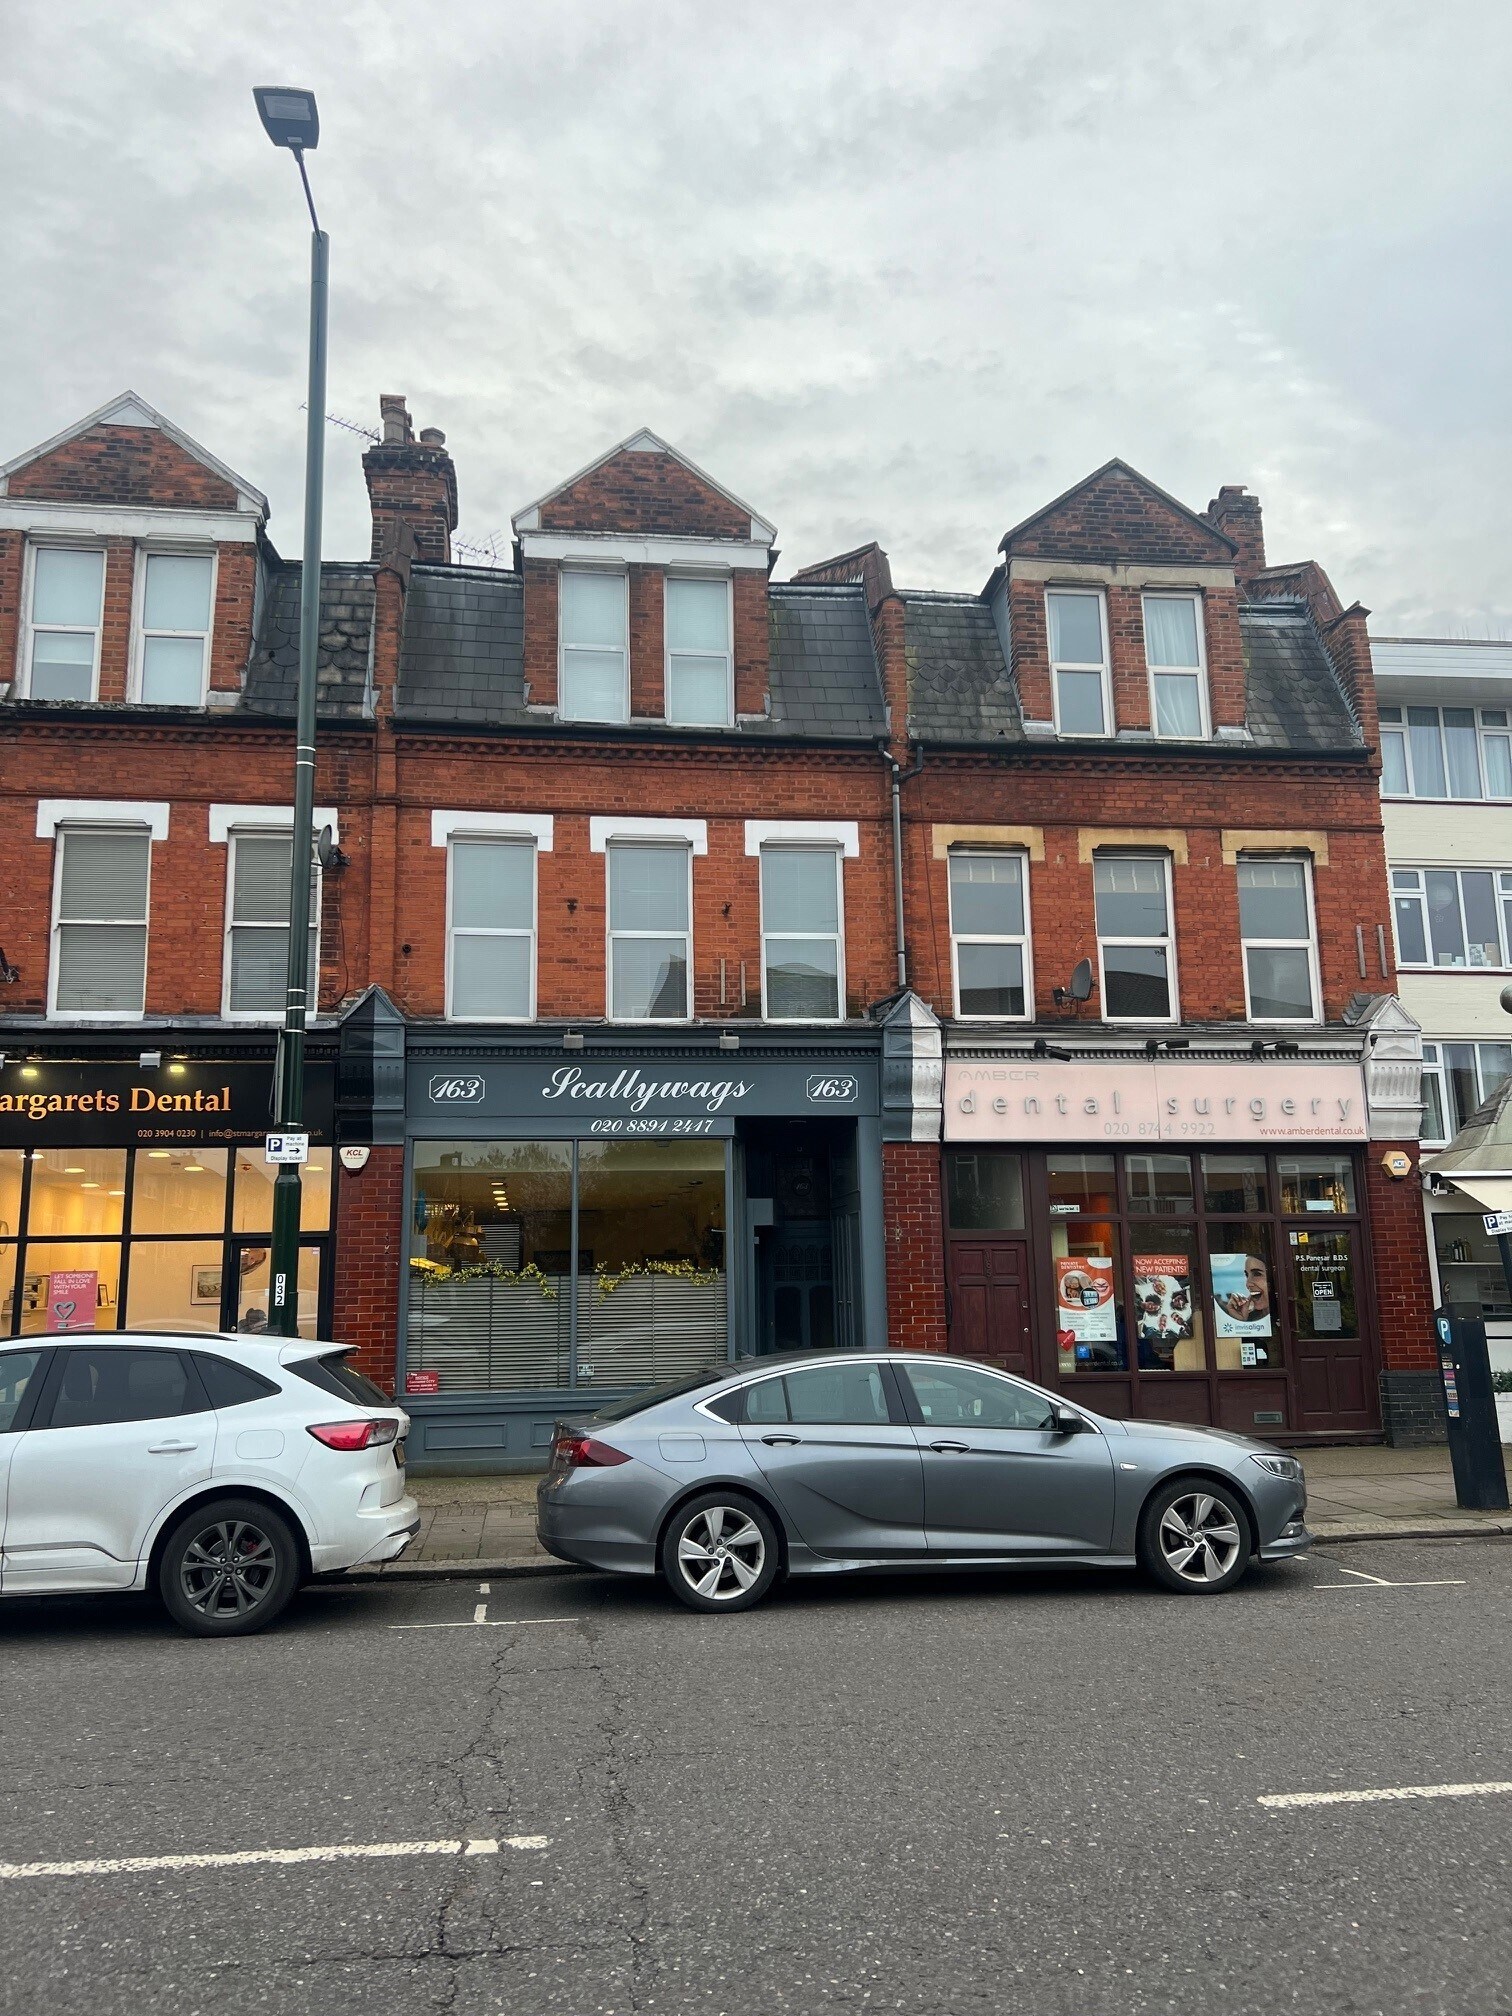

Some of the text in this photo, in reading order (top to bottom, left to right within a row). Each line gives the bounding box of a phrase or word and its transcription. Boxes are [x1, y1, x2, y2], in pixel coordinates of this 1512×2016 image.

[958, 1070, 1040, 1080] AMBER
[432, 1080, 480, 1098] 163
[541, 1066, 754, 1112] Scallywags
[810, 1080, 854, 1098] 163
[128, 1087, 232, 1112] Dental
[959, 1090, 1351, 1122] dental surgery
[590, 1120, 714, 1133] 020 8891 2417
[1104, 1122, 1216, 1135] 020 8744 9922
[1260, 1126, 1364, 1136] www.amberdental.co.uk
[137, 1130, 153, 1138] 020
[155, 1130, 174, 1138] 3904
[176, 1130, 196, 1138] 0230
[270, 1140, 281, 1150] P
[1487, 1216, 1496, 1228] P
[276, 1275, 284, 1304] 032
[1235, 1323, 1265, 1331] invisalign
[1441, 1320, 1448, 1340] P
